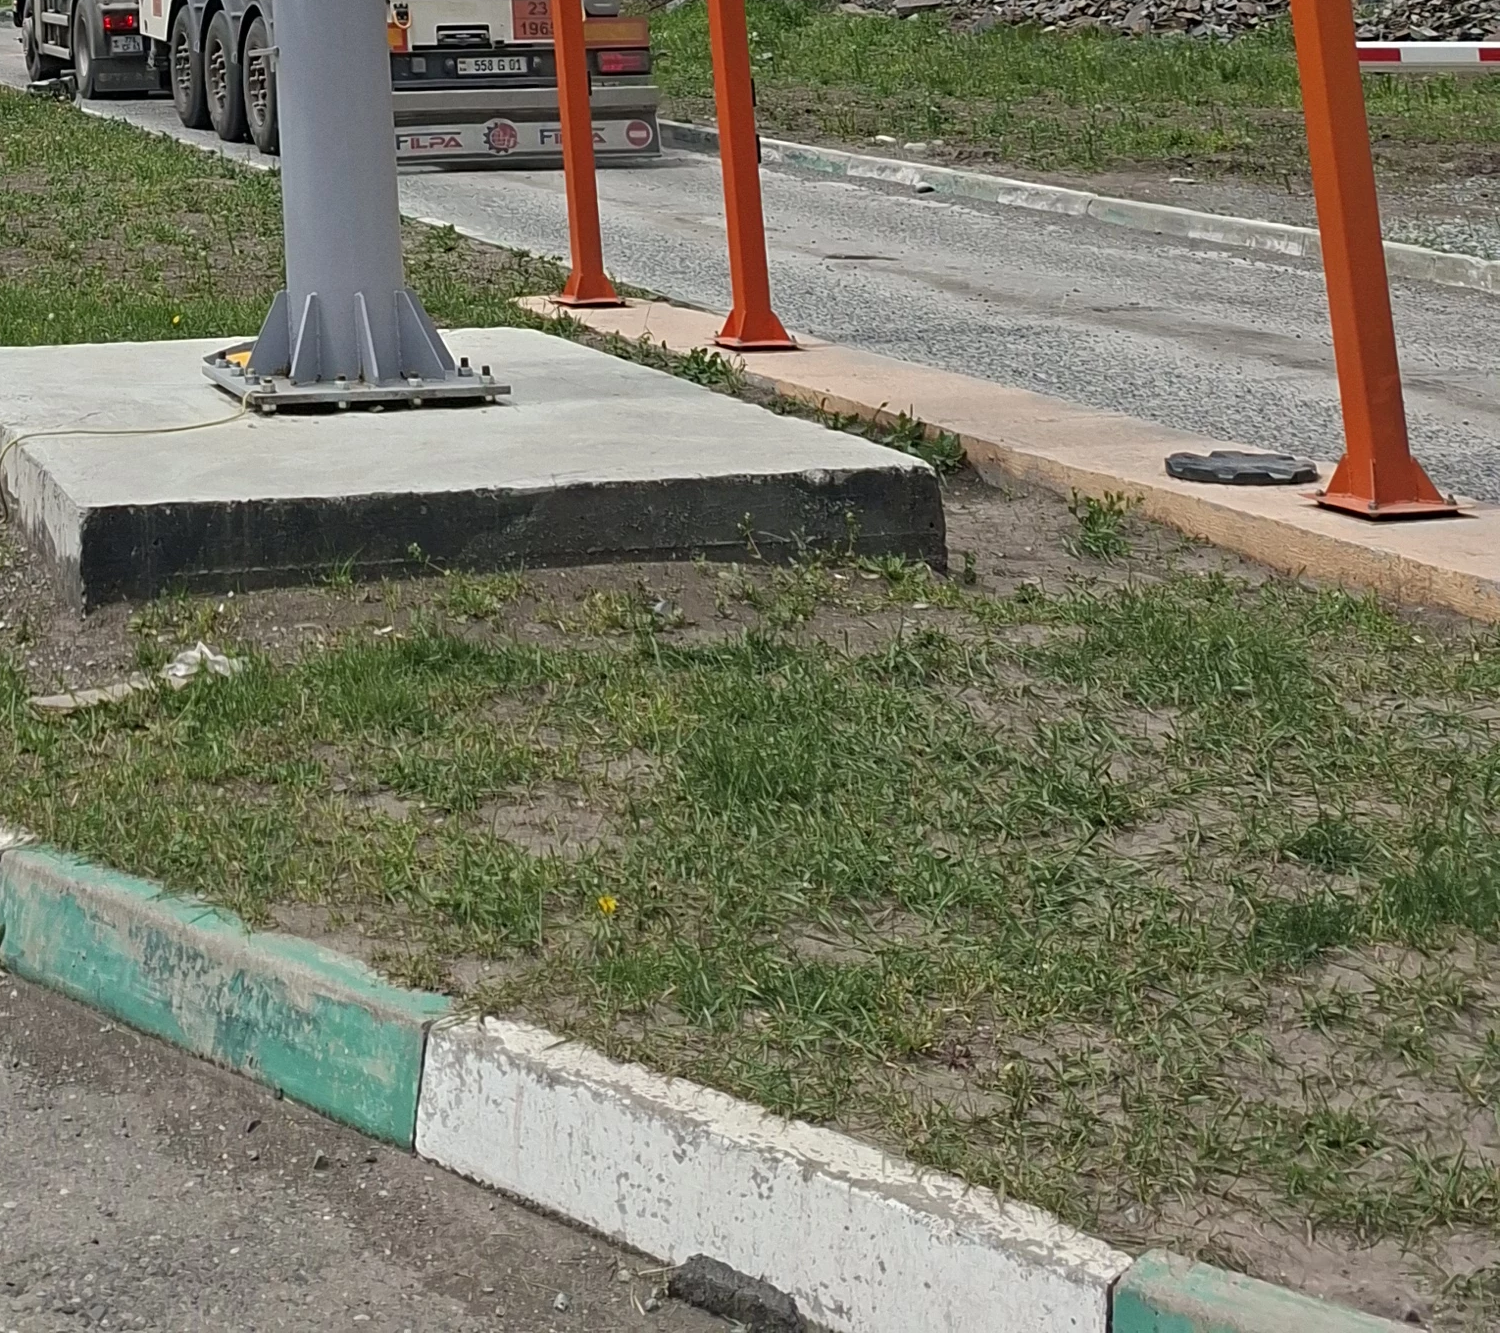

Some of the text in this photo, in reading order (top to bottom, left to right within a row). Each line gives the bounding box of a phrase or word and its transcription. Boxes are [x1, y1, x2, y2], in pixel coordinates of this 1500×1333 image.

[528, 0, 548, 17] 23
[474, 58, 494, 72] 558
[497, 58, 506, 72] G
[509, 58, 522, 71] 01
[395, 131, 463, 151] FILPA
